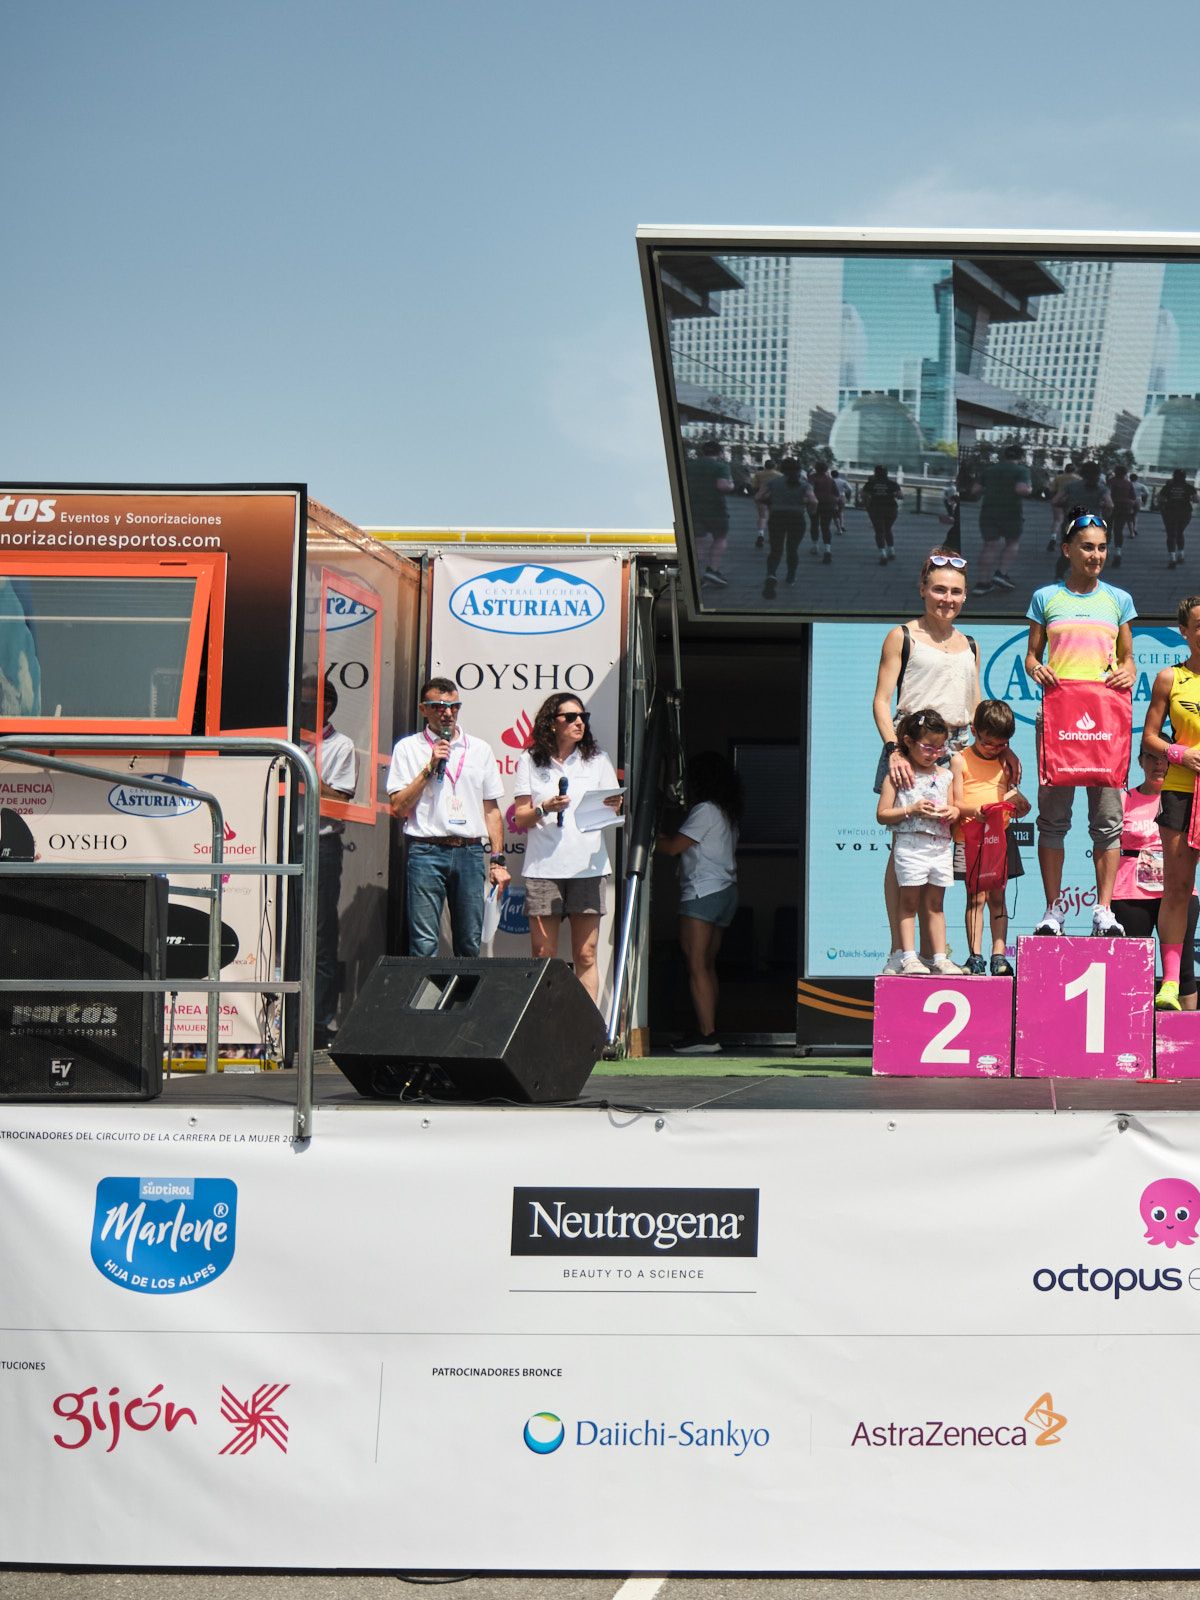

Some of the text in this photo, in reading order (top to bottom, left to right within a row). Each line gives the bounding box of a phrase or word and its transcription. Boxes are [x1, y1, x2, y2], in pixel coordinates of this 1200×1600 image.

[60, 512, 109, 524] Eventos
[114, 514, 121, 525] y
[126, 512, 222, 525] Sonorizaciones
[0, 531, 221, 548] norizacionesportos.com
[460, 589, 592, 616] ASTURIANA
[456, 663, 594, 691] OYSHO
[1058, 730, 1112, 741] Santander
[6, 797, 18, 805] DE
[20, 797, 47, 805] JUNIO
[115, 789, 195, 807] ASTURIANA
[48, 833, 127, 850] OYSHO
[194, 843, 256, 855] Sanander
[1065, 962, 1106, 1053] 1
[920, 990, 971, 1064] 2
[76, 1132, 93, 1141] DEL
[96, 1132, 140, 1141] CIRCUITO
[143, 1133, 155, 1141] DE
[158, 1133, 170, 1141] LA
[172, 1133, 216, 1142] CARRERA
[219, 1134, 232, 1142] DE
[234, 1134, 246, 1143] LA
[248, 1135, 280, 1143] MUJER
[104, 1259, 217, 1289] HIJA DE LOS ALPES
[563, 1269, 704, 1279] BEAUTY TO A SCIENCE
[1033, 1264, 1182, 1300] octopus
[432, 1367, 563, 1377] PATROCINADORES BRONCE
[53, 1384, 198, 1452] gijón
[576, 1419, 770, 1456] Daiichi-Sankyo
[851, 1421, 1027, 1447] AstraZeneca
